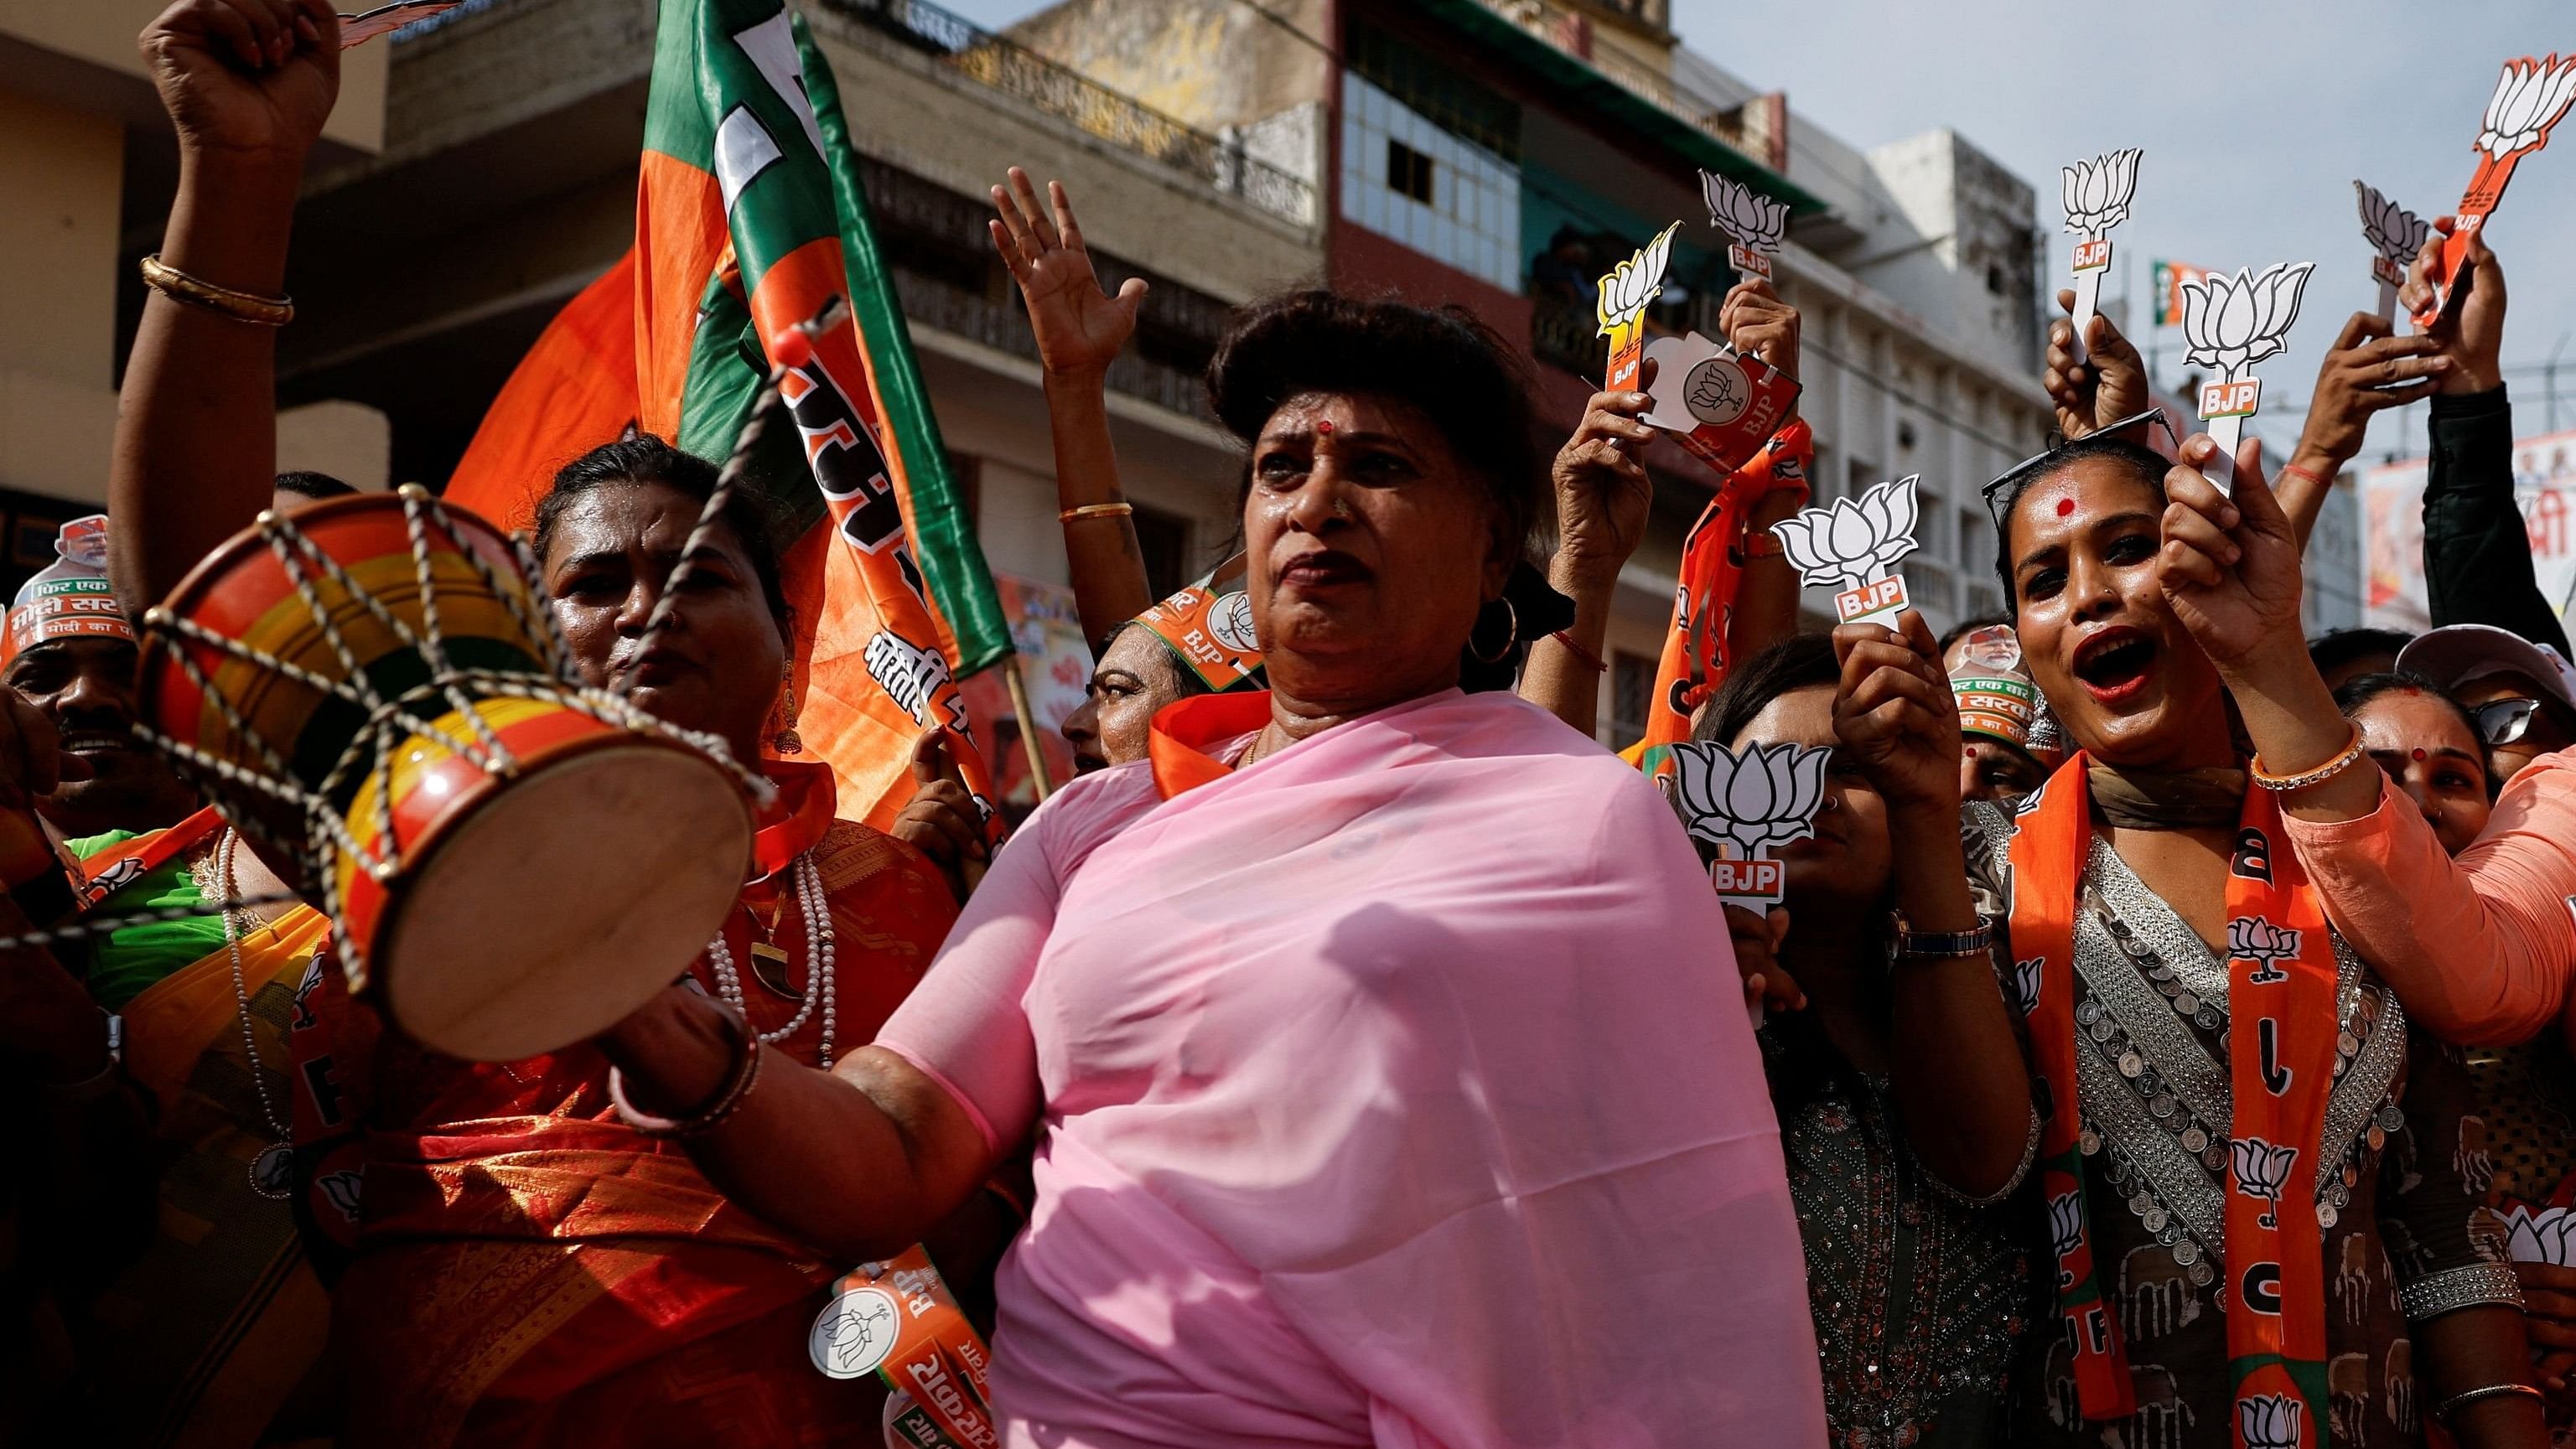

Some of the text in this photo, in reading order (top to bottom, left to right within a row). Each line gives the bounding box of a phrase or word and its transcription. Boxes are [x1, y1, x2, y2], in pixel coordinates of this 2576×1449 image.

[2454, 214, 2480, 232] BJP
[1734, 247, 1768, 272] BJP
[2075, 243, 2107, 267] BJP
[1614, 359, 1637, 386] BJP
[2205, 386, 2255, 414] BJP
[1741, 394, 1775, 437] BJP
[1841, 581, 1899, 618] BJP
[46, 620, 81, 634] मोदी
[87, 622, 112, 632] का
[1181, 628, 1224, 665] BJP
[1974, 680, 2003, 691] एक
[1981, 719, 2003, 731] का
[1715, 863, 1777, 892] BJP
[893, 1269, 937, 1319] BJP
